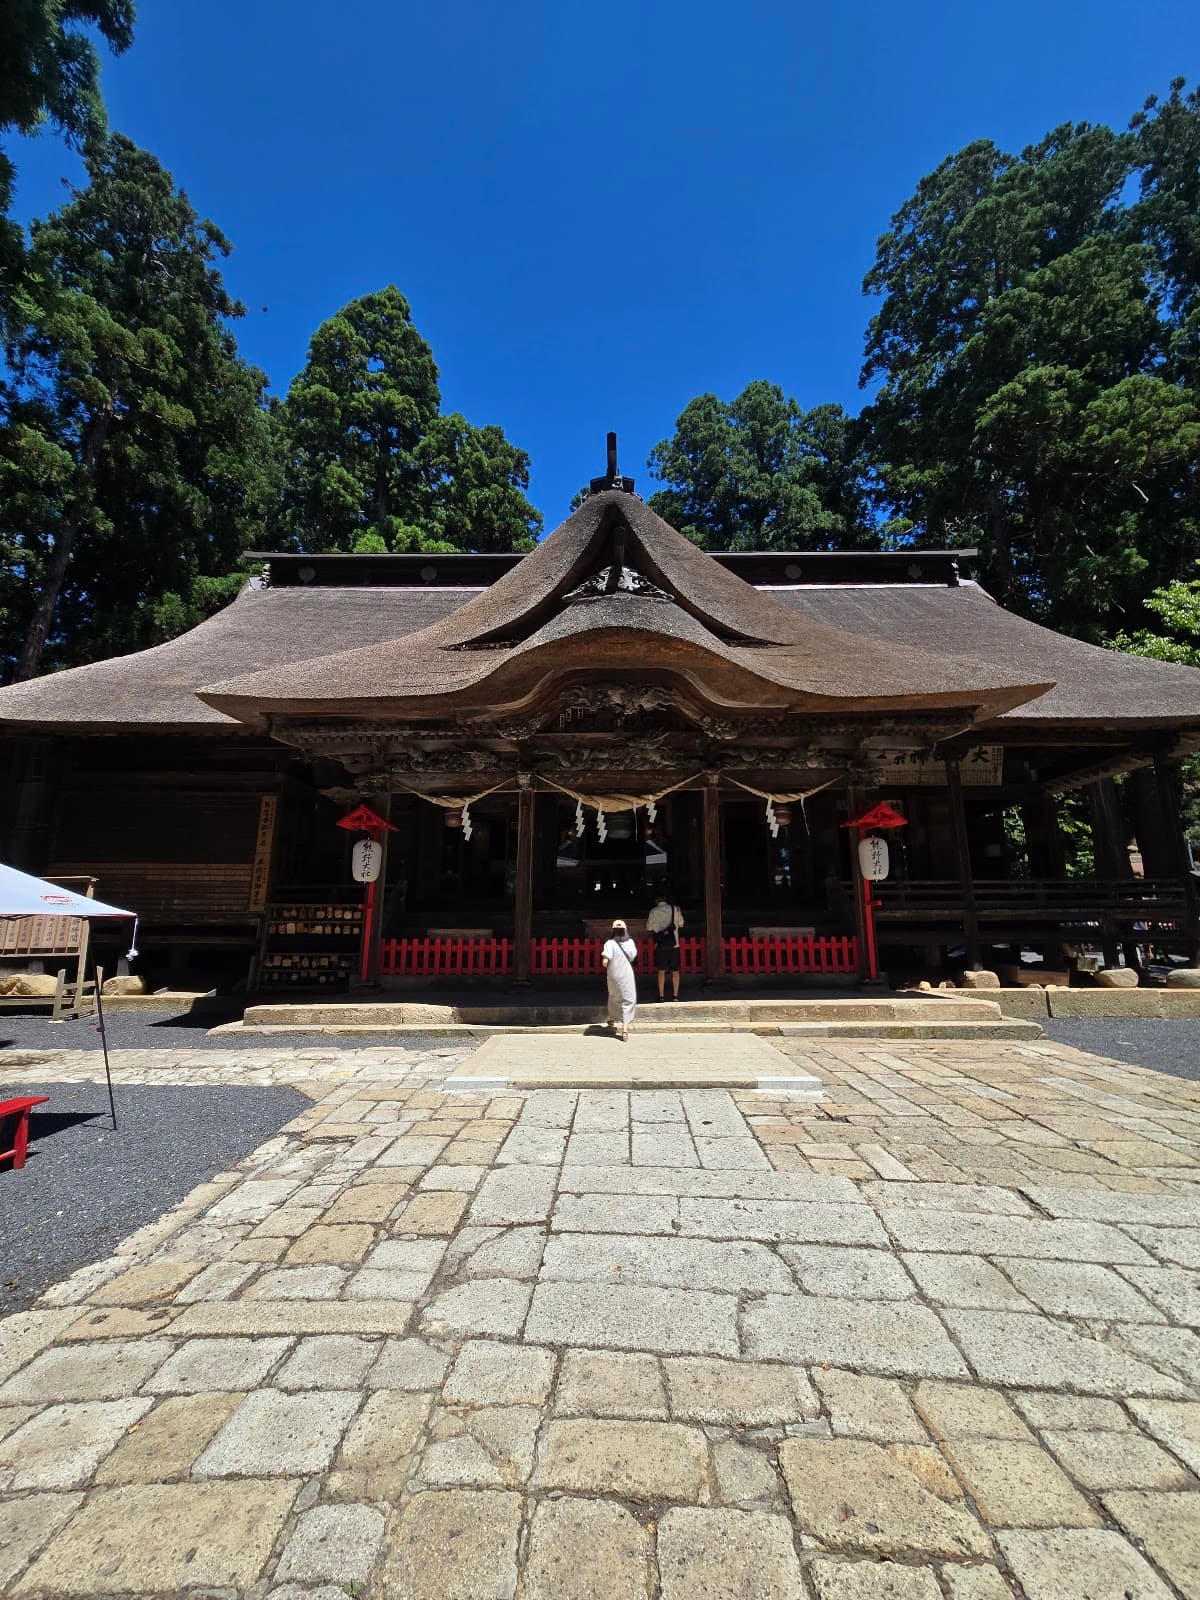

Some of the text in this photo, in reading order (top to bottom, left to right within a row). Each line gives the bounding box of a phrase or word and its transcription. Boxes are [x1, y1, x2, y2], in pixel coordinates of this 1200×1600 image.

[361, 843, 373, 878] 熊野大社
[870, 840, 882, 876] 熊野大社
